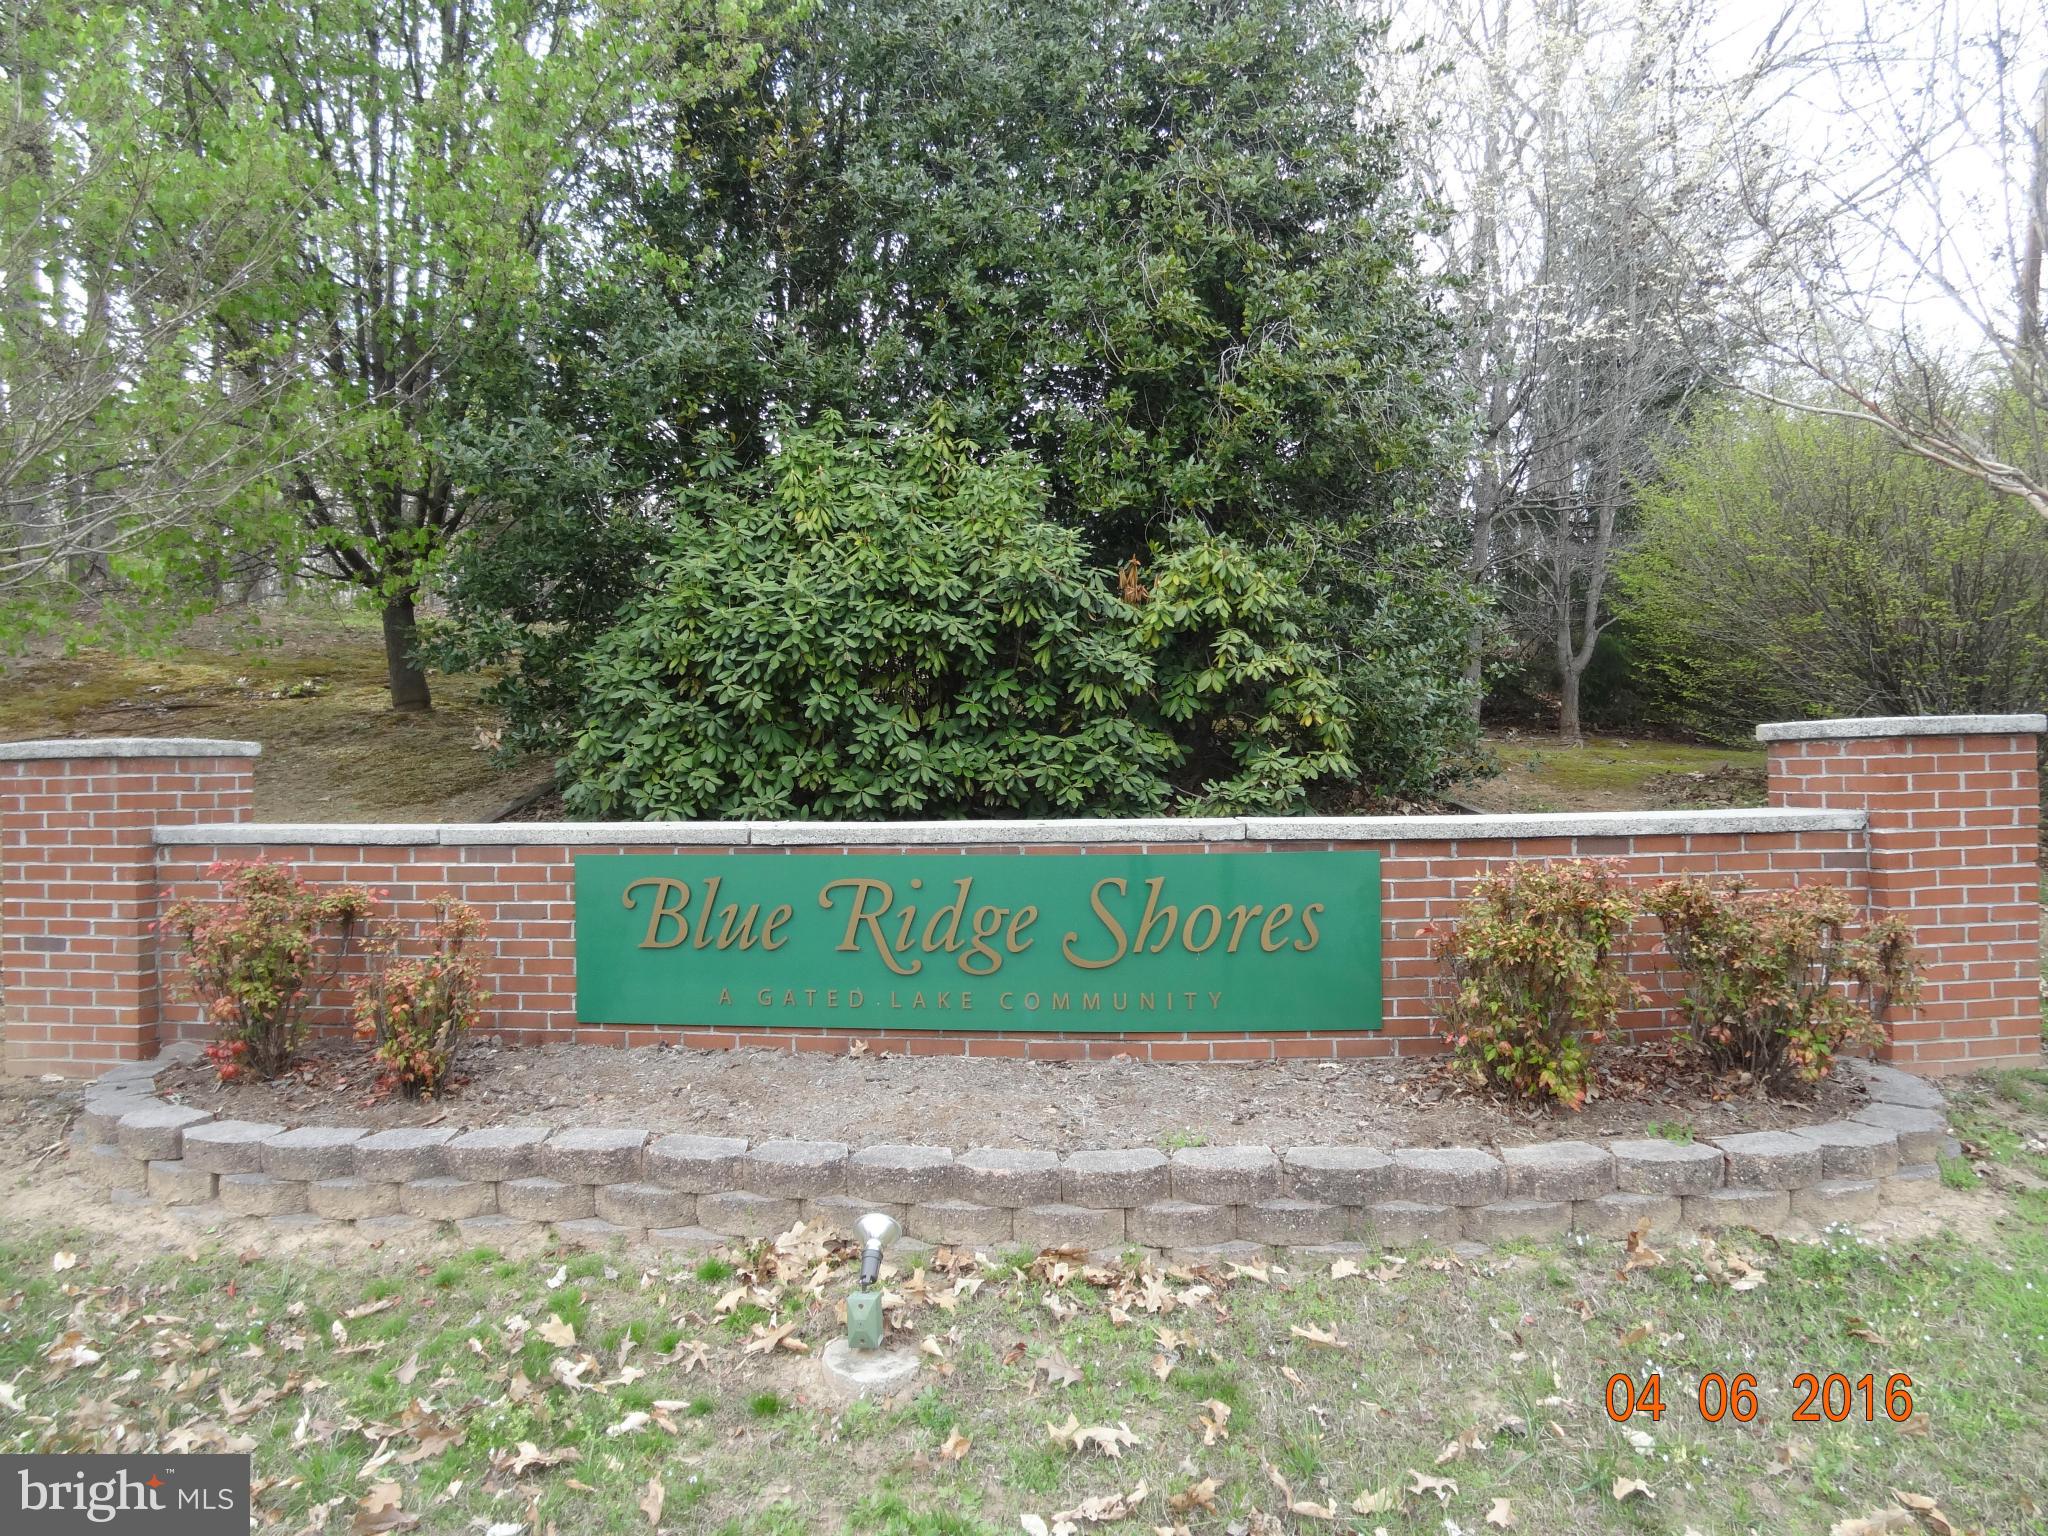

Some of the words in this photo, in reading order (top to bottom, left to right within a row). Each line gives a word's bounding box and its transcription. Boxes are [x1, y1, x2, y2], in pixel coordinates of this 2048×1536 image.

[622, 876, 793, 951] Blue
[818, 876, 1038, 976] Ridge
[1062, 876, 1325, 970] Shores
[719, 988, 732, 1006] A
[757, 988, 865, 1009] GATED
[890, 991, 973, 1009] LAKE
[1000, 991, 1223, 1011] COMMUNITY
